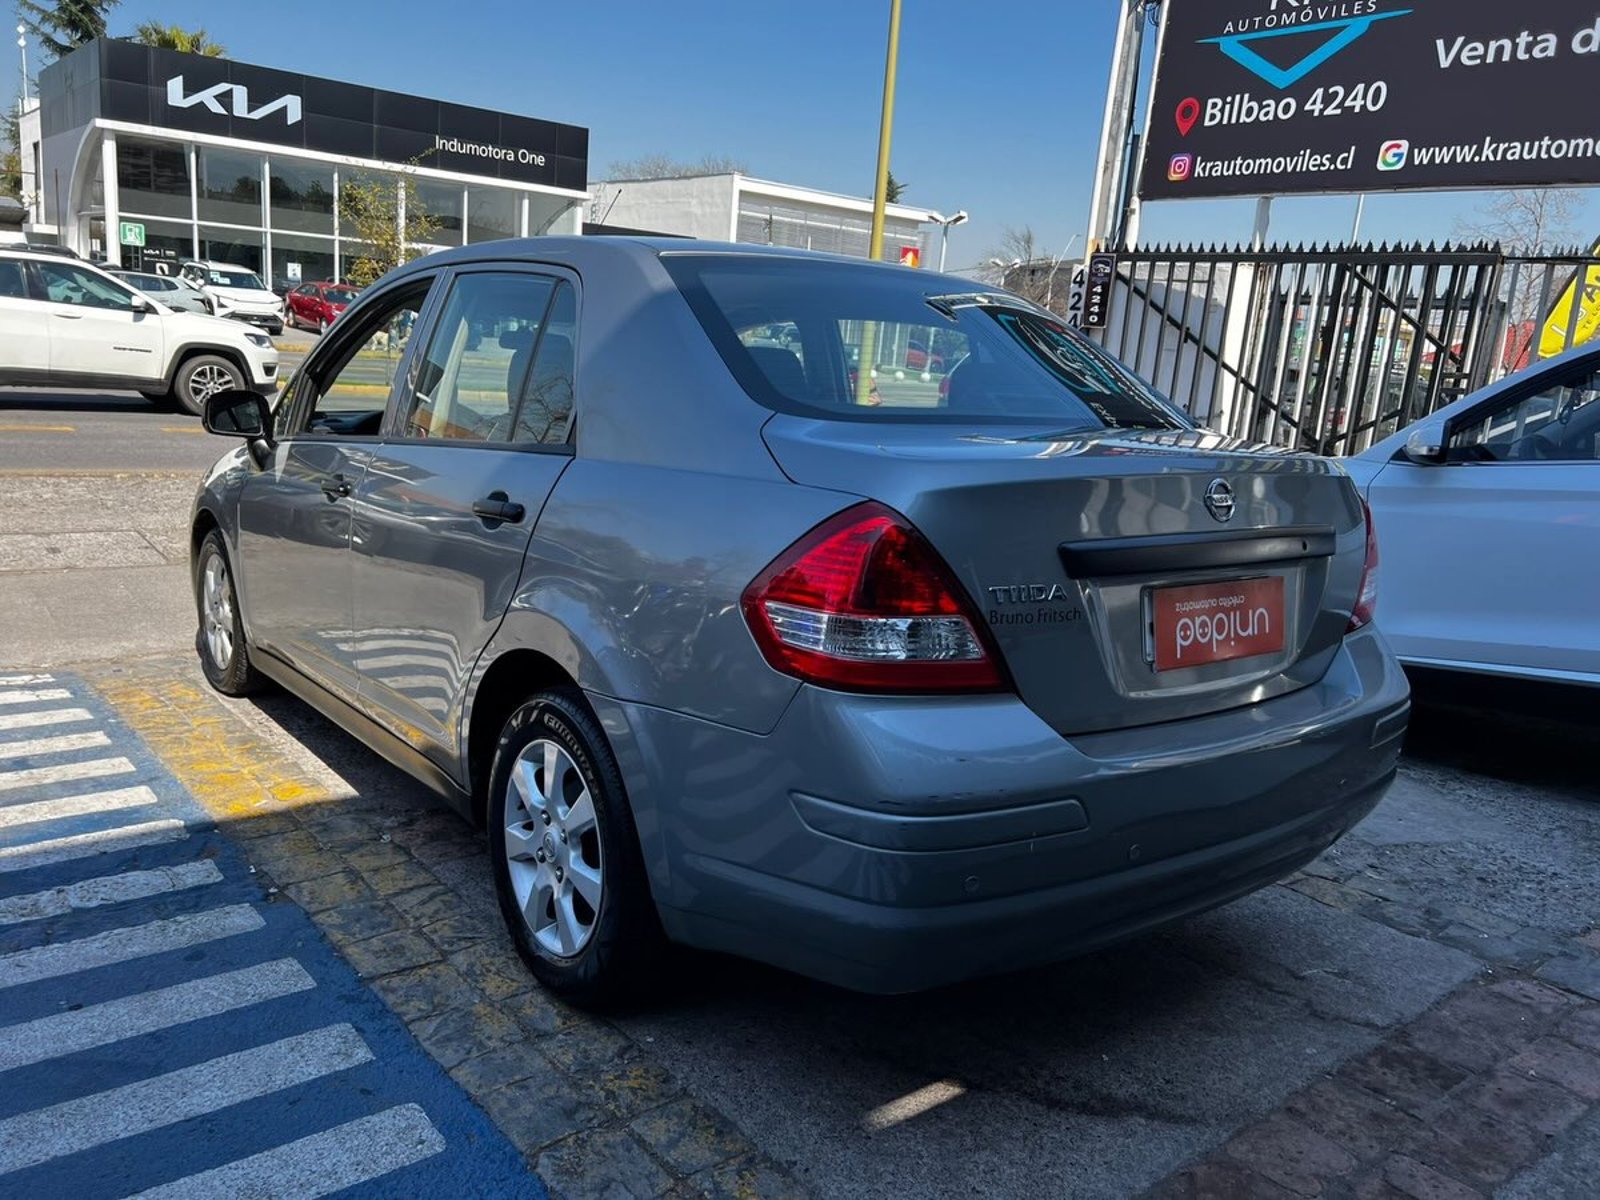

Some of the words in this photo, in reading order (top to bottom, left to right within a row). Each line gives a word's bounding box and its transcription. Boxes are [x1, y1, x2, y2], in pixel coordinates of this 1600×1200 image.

[1223, 0, 1377, 34] AUTOMÓVILES
[1435, 30, 1558, 69] Venta
[1203, 93, 1297, 127] Bilbao
[1303, 81, 1388, 117] 4240
[435, 135, 515, 162] Indumotora
[518, 149, 546, 166] One
[1194, 146, 1356, 177] krautomoviles.cl
[1413, 136, 1600, 165] www.krautom
[1089, 285, 1102, 323] 4240
[988, 584, 1069, 603] TIIDA
[1175, 598, 1217, 613] automotriz
[989, 609, 1034, 625] Bruno
[1037, 607, 1081, 623] Fritsch
[1176, 607, 1269, 659] unidad
